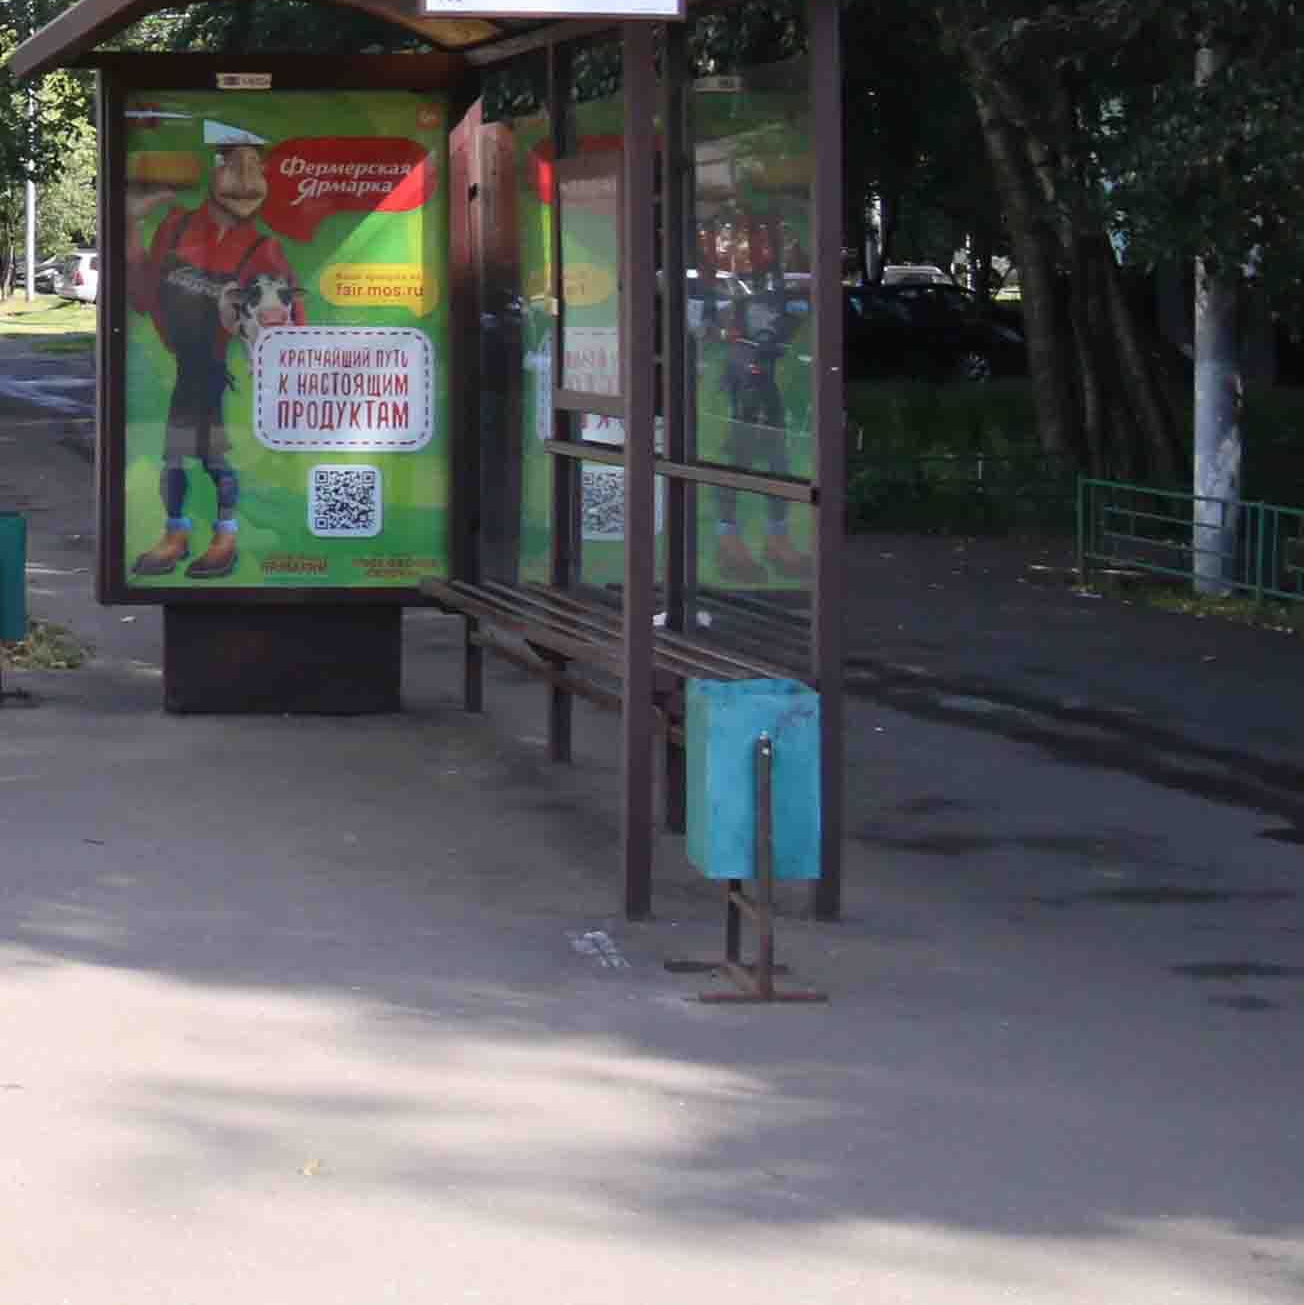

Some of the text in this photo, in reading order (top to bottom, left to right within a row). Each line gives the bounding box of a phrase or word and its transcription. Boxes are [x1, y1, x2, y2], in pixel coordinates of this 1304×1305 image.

[280, 155, 411, 179] Фермерская
[290, 178, 393, 206] Ярмарка
[279, 347, 409, 368] КРАТЧАЙШИЙ ПУТЬ
[278, 372, 408, 397] К НАСТОЯЩИМ
[277, 400, 409, 431] ПРОДУКТАМ
